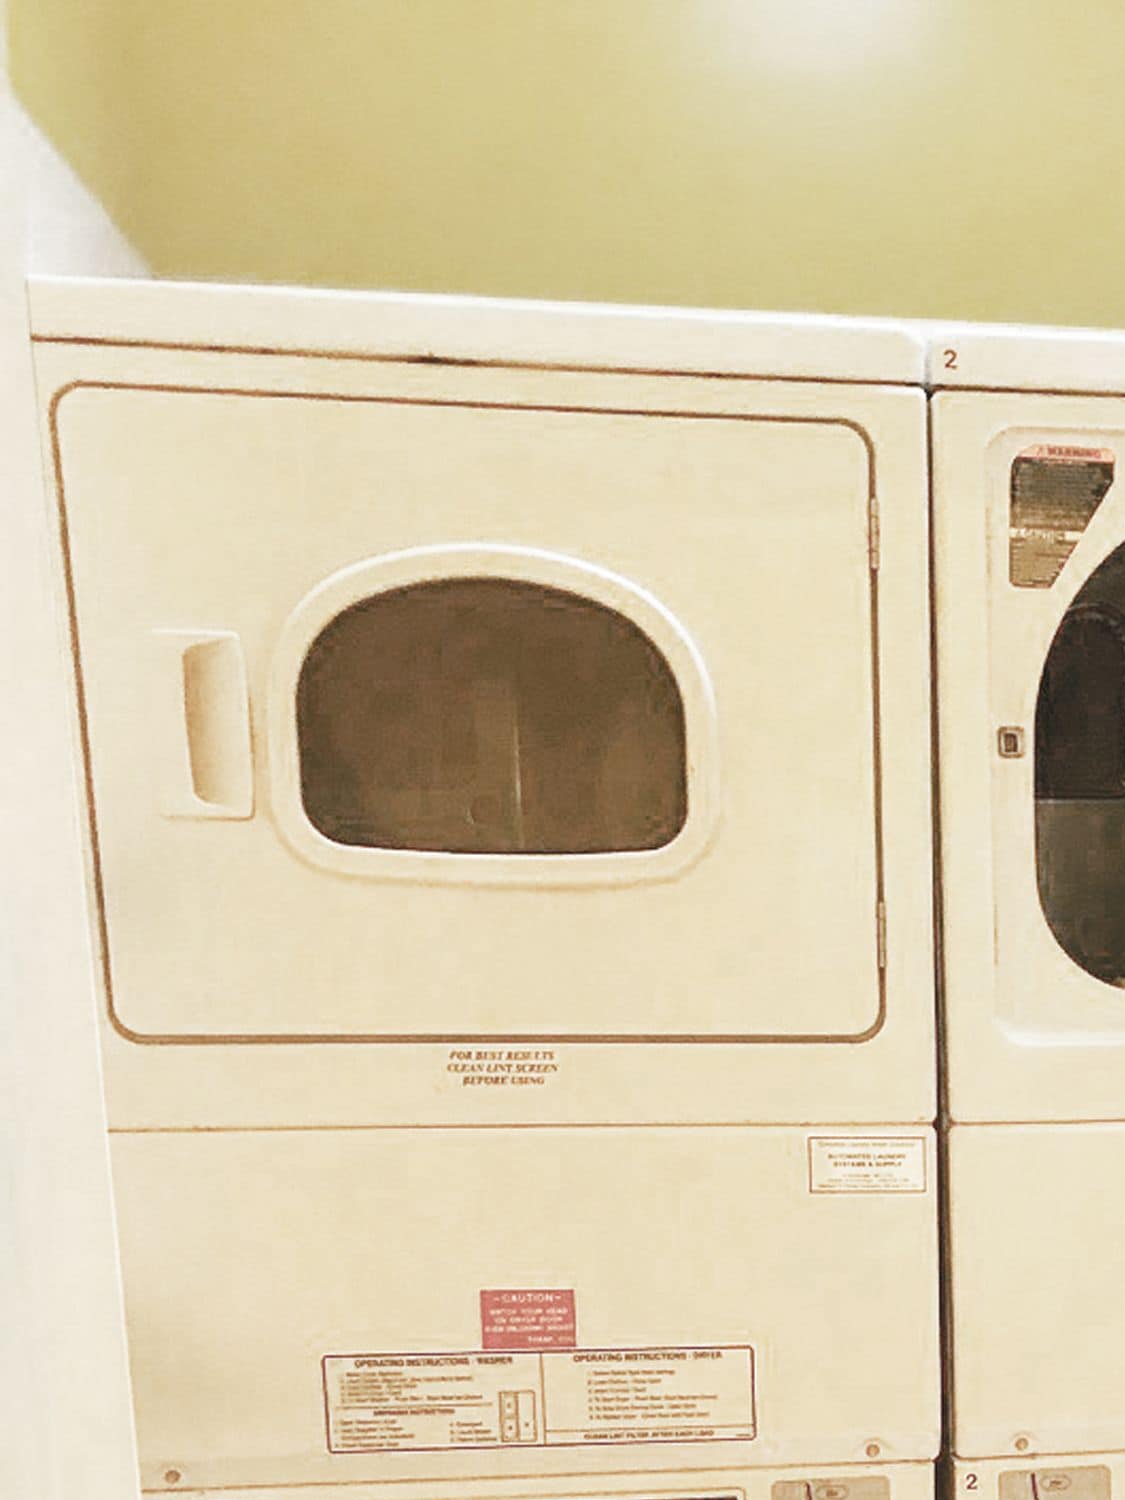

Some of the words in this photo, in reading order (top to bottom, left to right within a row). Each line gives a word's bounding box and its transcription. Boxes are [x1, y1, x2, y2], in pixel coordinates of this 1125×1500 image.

[943, 348, 958, 371] 2
[449, 1051, 472, 1060] FOR
[447, 1063, 485, 1072] CLEAN
[487, 1063, 512, 1072] LINT
[515, 1063, 558, 1073] SCREEN
[463, 1076, 509, 1085] BEFORE
[511, 1076, 545, 1085] USING
[965, 1473, 978, 1490] 2
